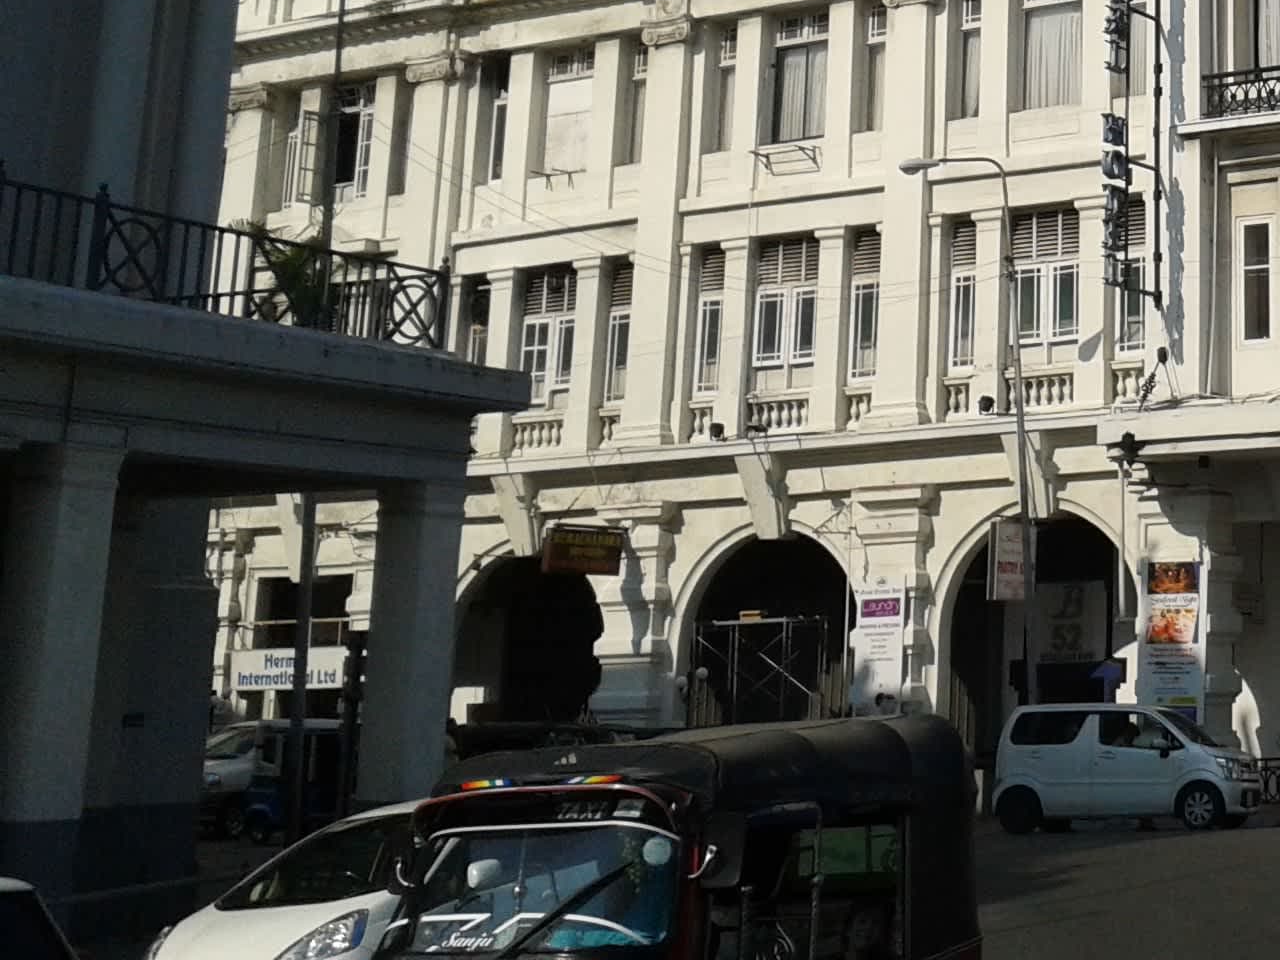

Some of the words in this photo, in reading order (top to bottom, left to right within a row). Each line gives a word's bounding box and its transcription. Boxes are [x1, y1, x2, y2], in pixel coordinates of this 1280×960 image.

[264, 654, 295, 670] Herm
[238, 669, 314, 686] Internatioal
[317, 668, 337, 685] Ltd
